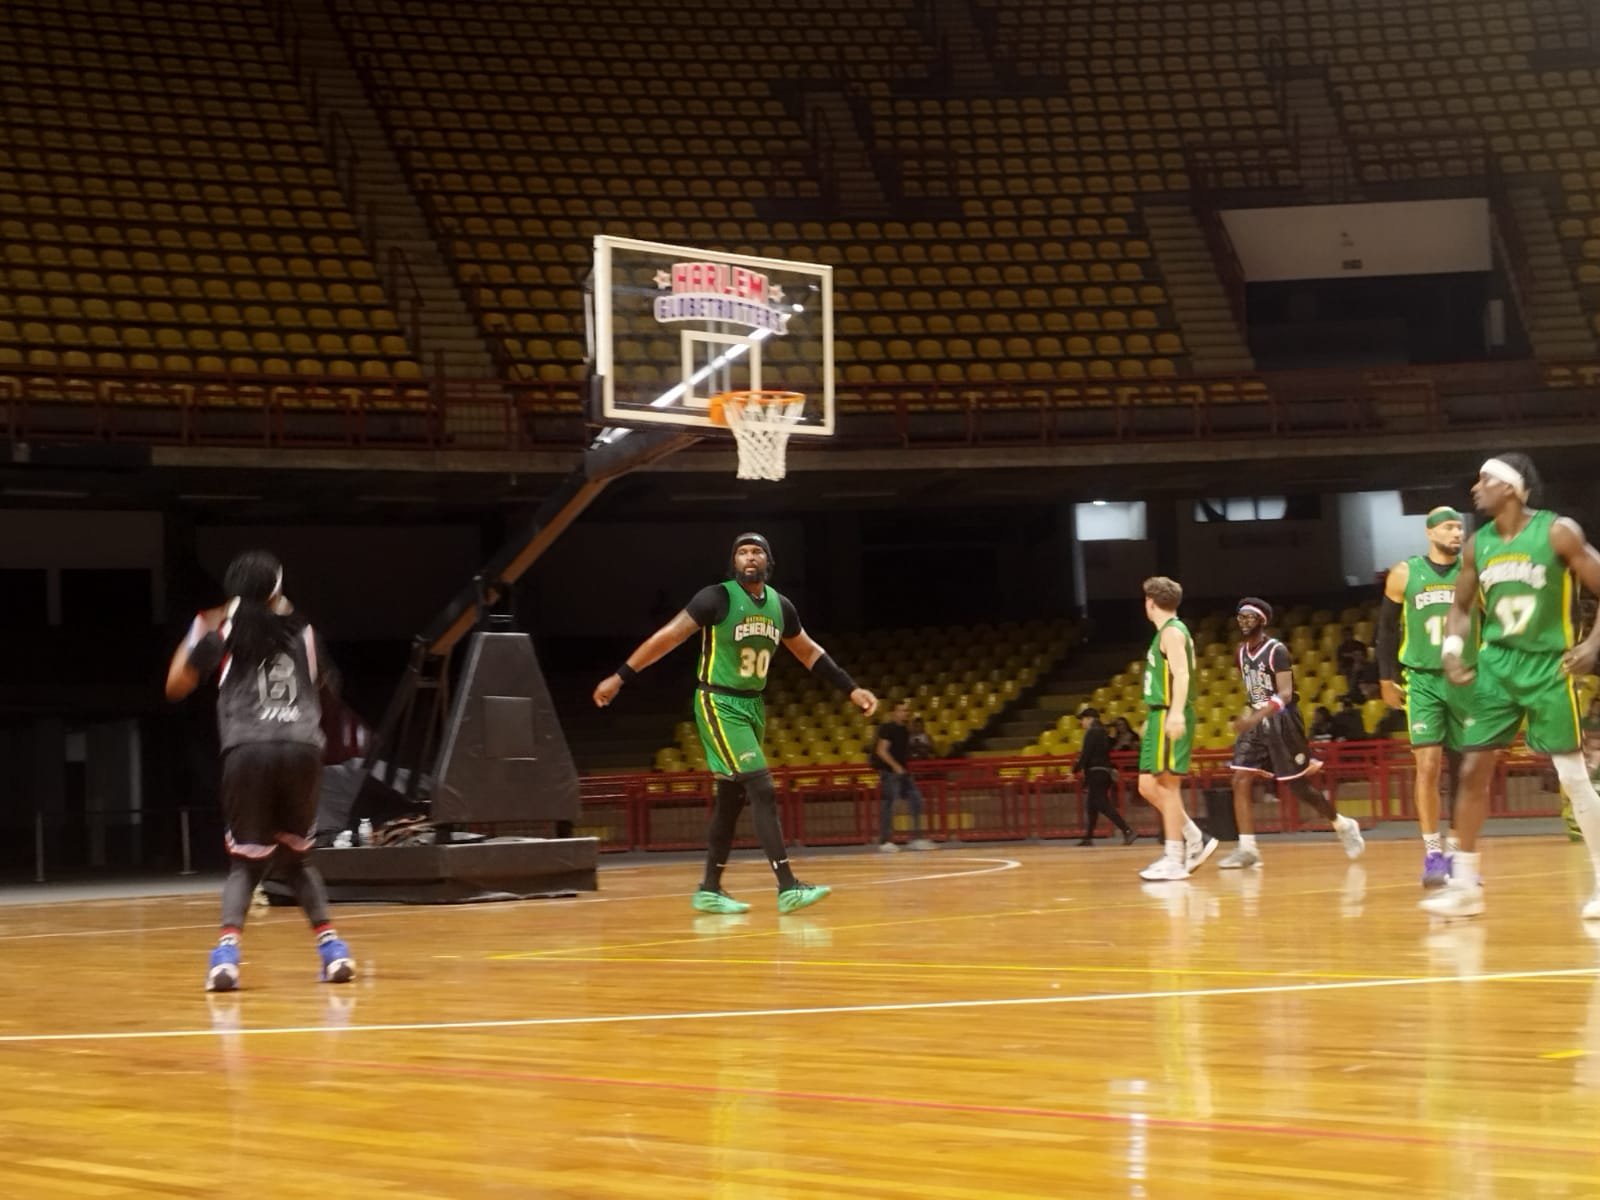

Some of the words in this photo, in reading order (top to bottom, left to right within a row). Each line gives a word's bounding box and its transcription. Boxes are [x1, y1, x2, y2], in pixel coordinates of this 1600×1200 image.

[671, 262, 769, 305] HARLEM
[1495, 594, 1537, 637] 17
[739, 647, 771, 679] 30
